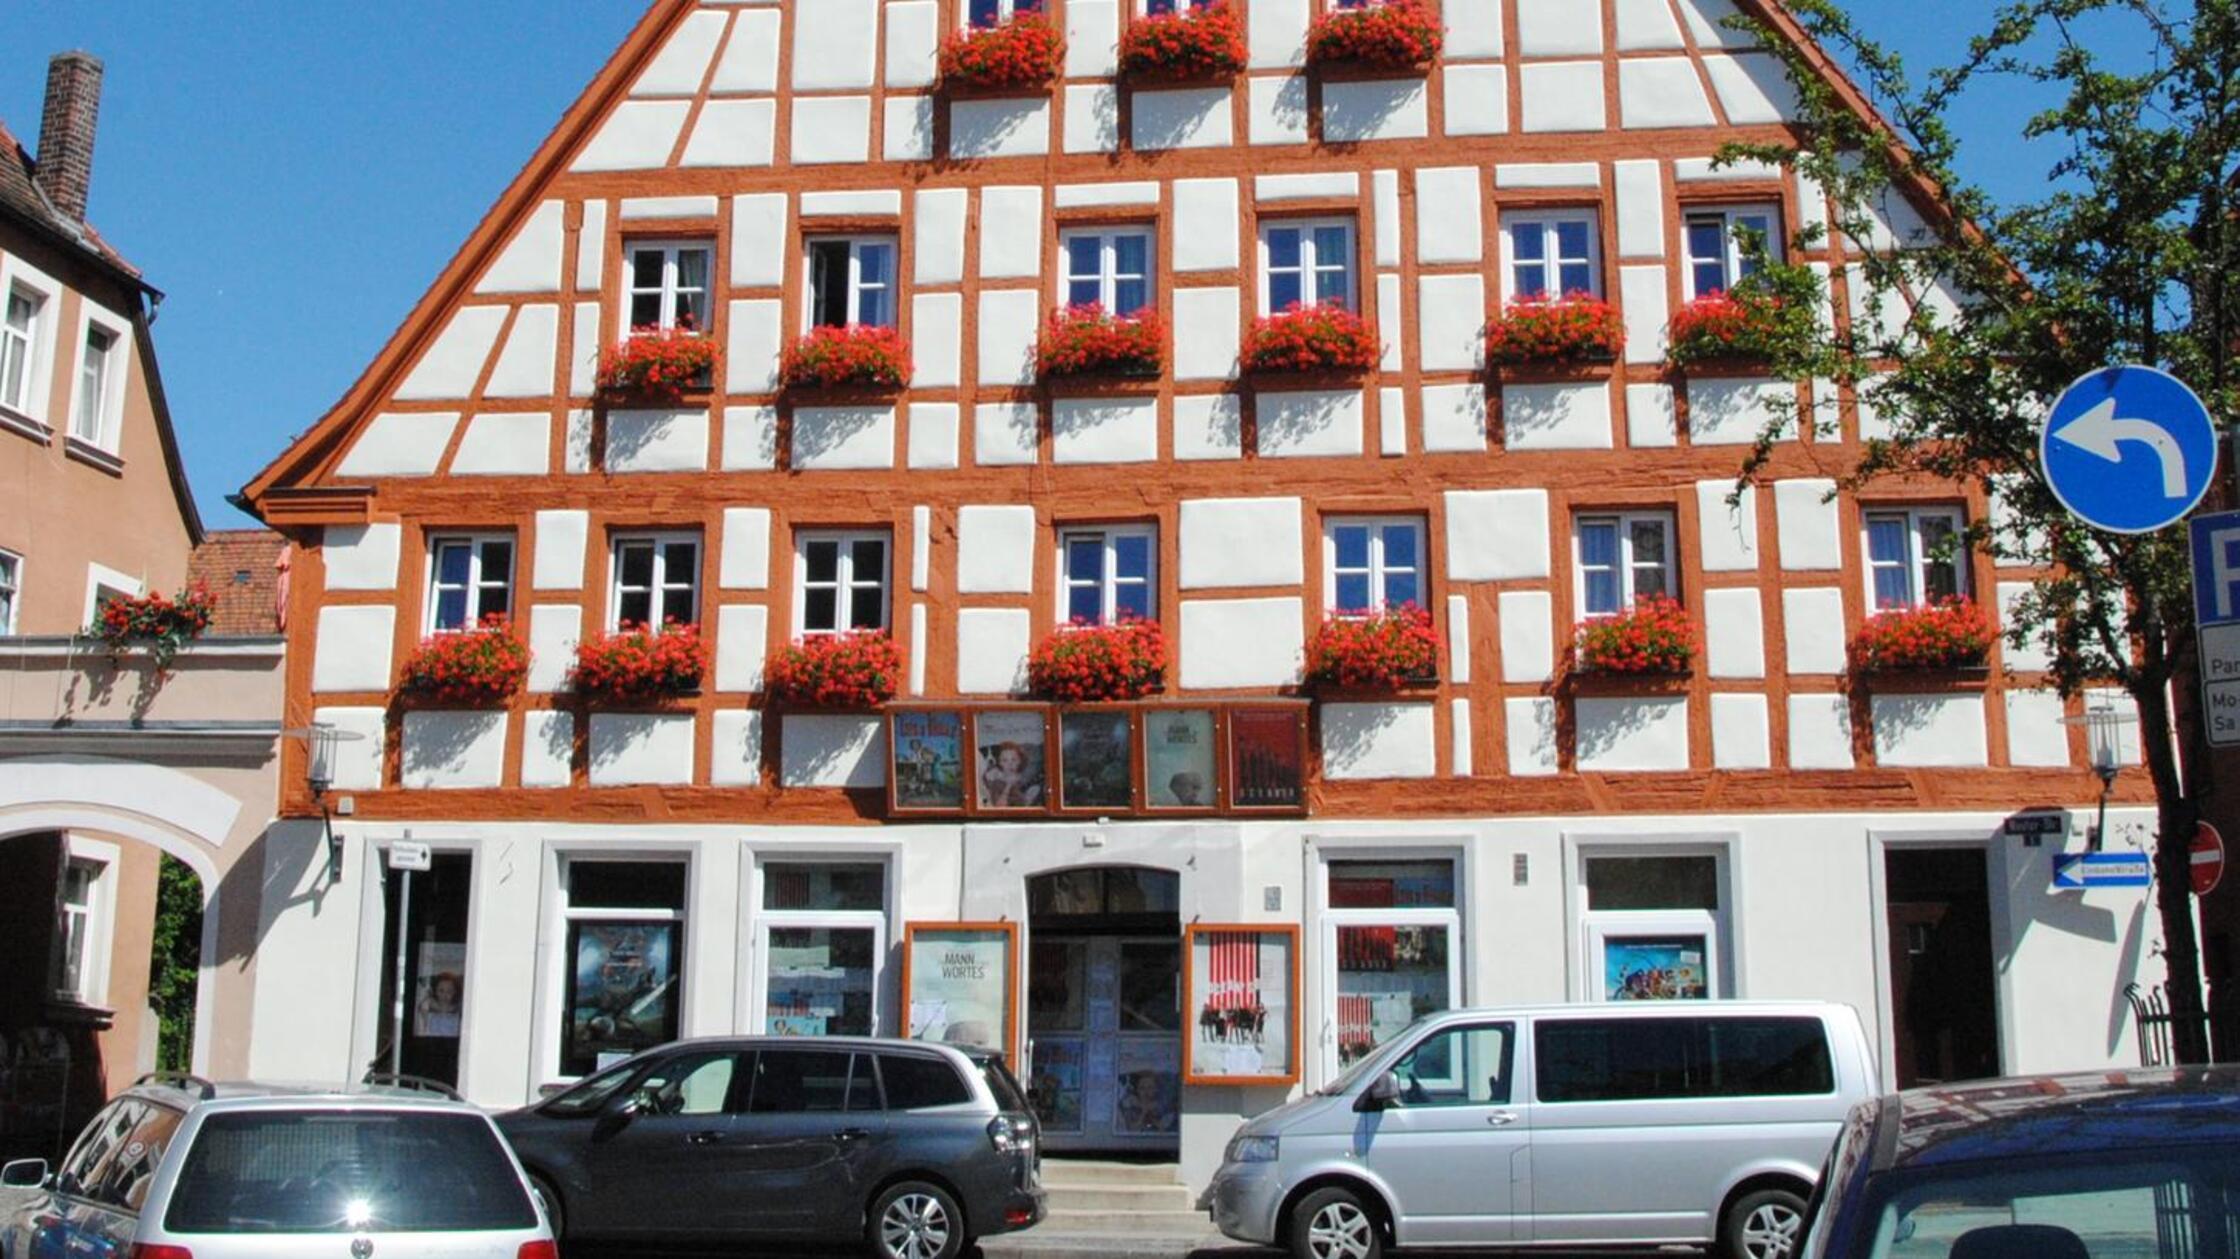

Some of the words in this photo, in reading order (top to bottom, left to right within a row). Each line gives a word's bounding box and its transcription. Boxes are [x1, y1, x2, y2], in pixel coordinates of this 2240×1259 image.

[2214, 715, 2236, 731] Sa
[944, 952, 976, 965] MANN
[942, 966, 985, 979] WORTES
